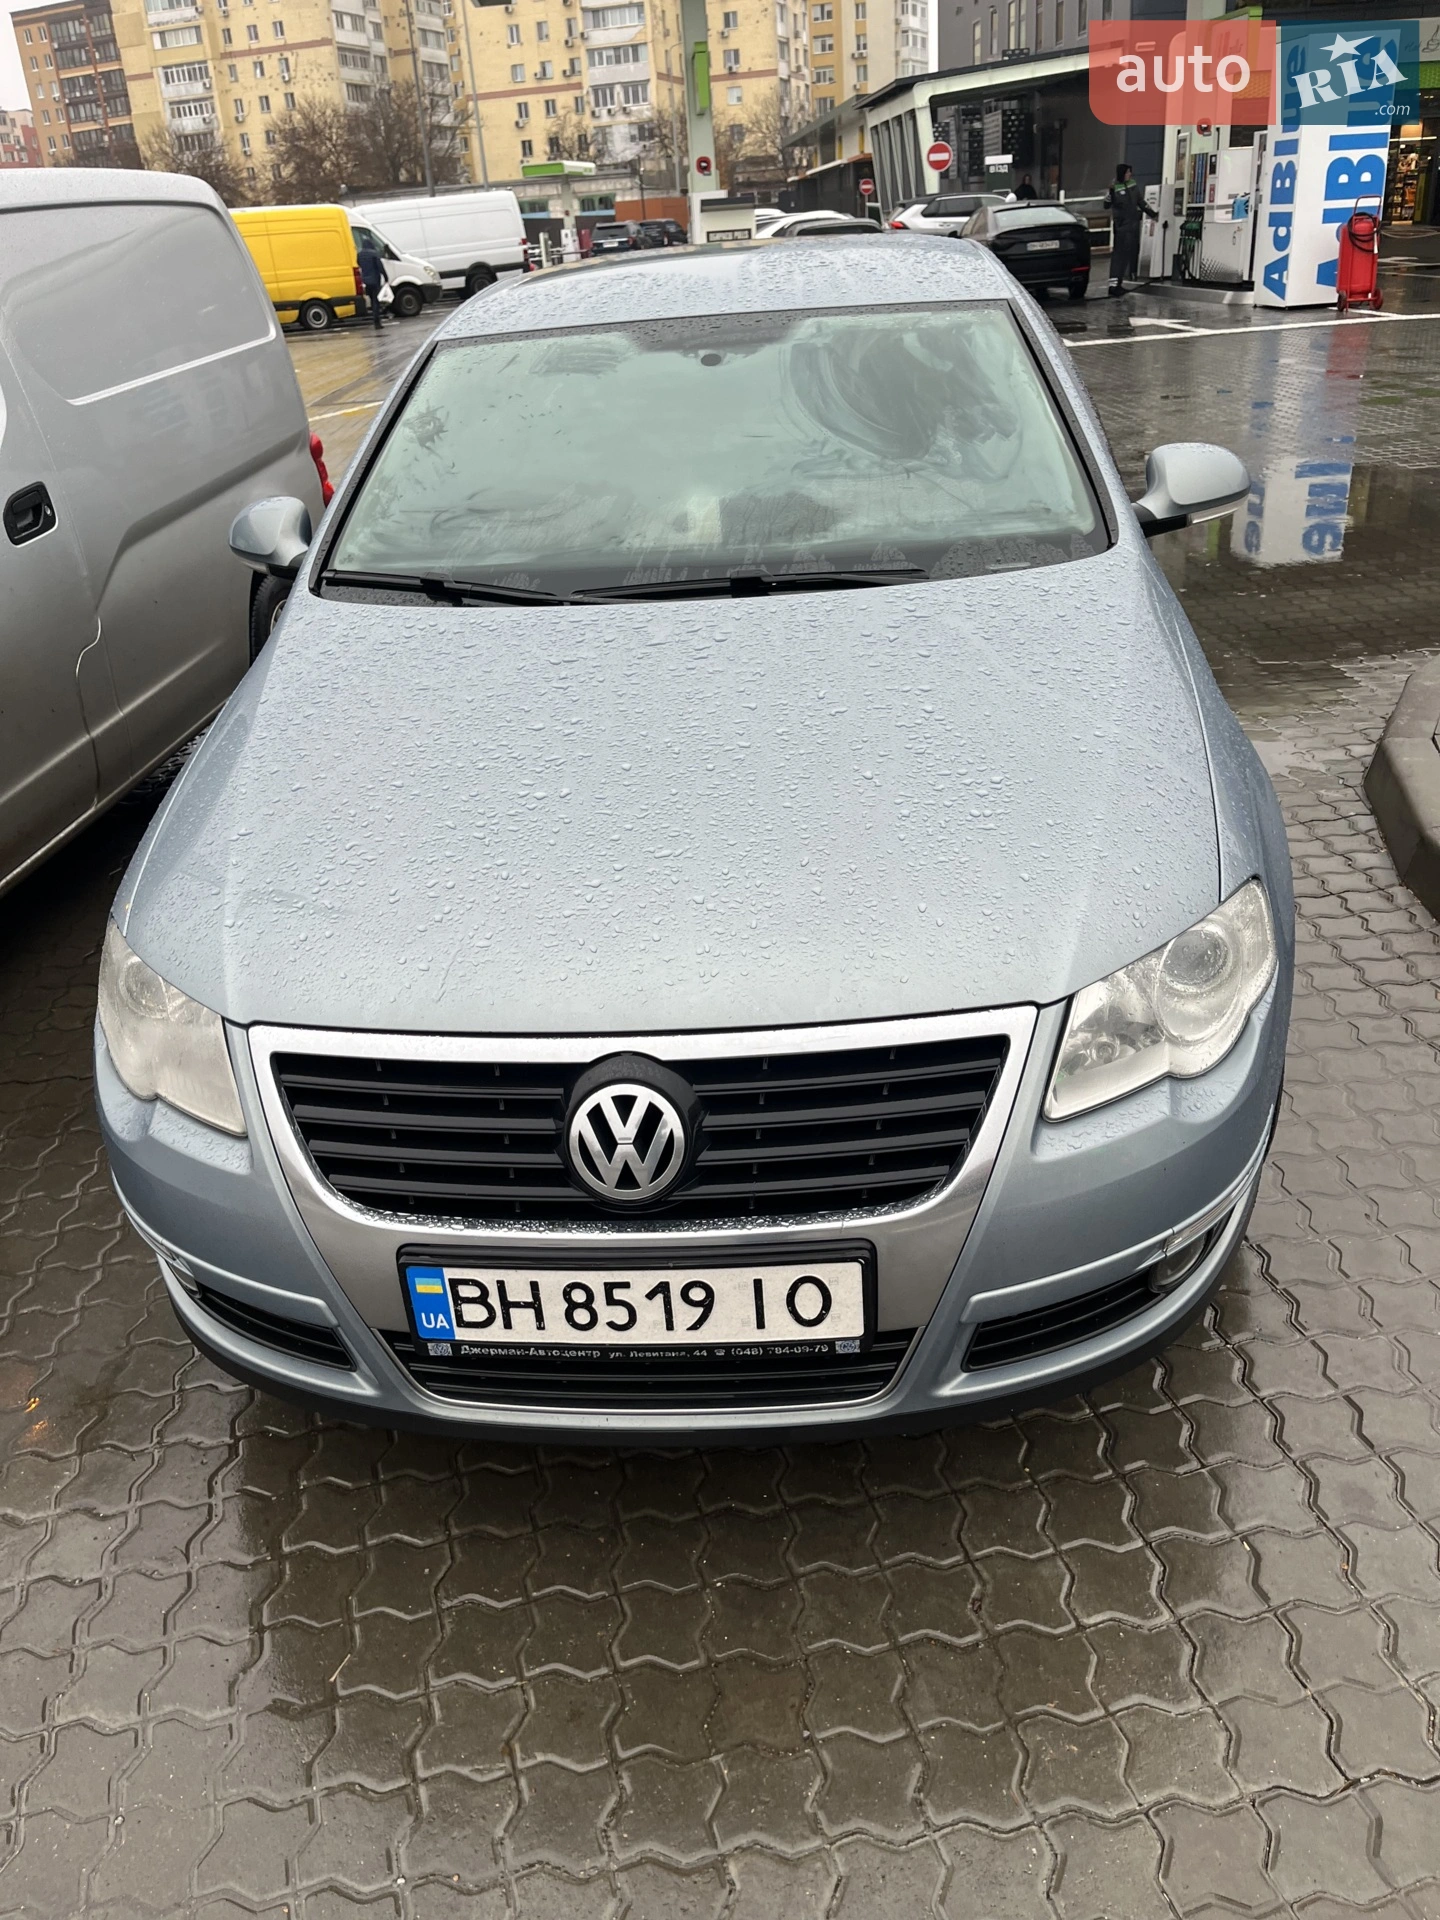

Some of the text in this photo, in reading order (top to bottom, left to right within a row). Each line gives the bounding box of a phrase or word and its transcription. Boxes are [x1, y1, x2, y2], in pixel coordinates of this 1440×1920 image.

[1263, 44, 1306, 301] AdBlue
[421, 1312, 450, 1329] UA
[447, 1277, 546, 1330] BH
[562, 1279, 715, 1331] 8519
[693, 1349, 708, 1357] 44
[731, 1347, 763, 1356] (048)
